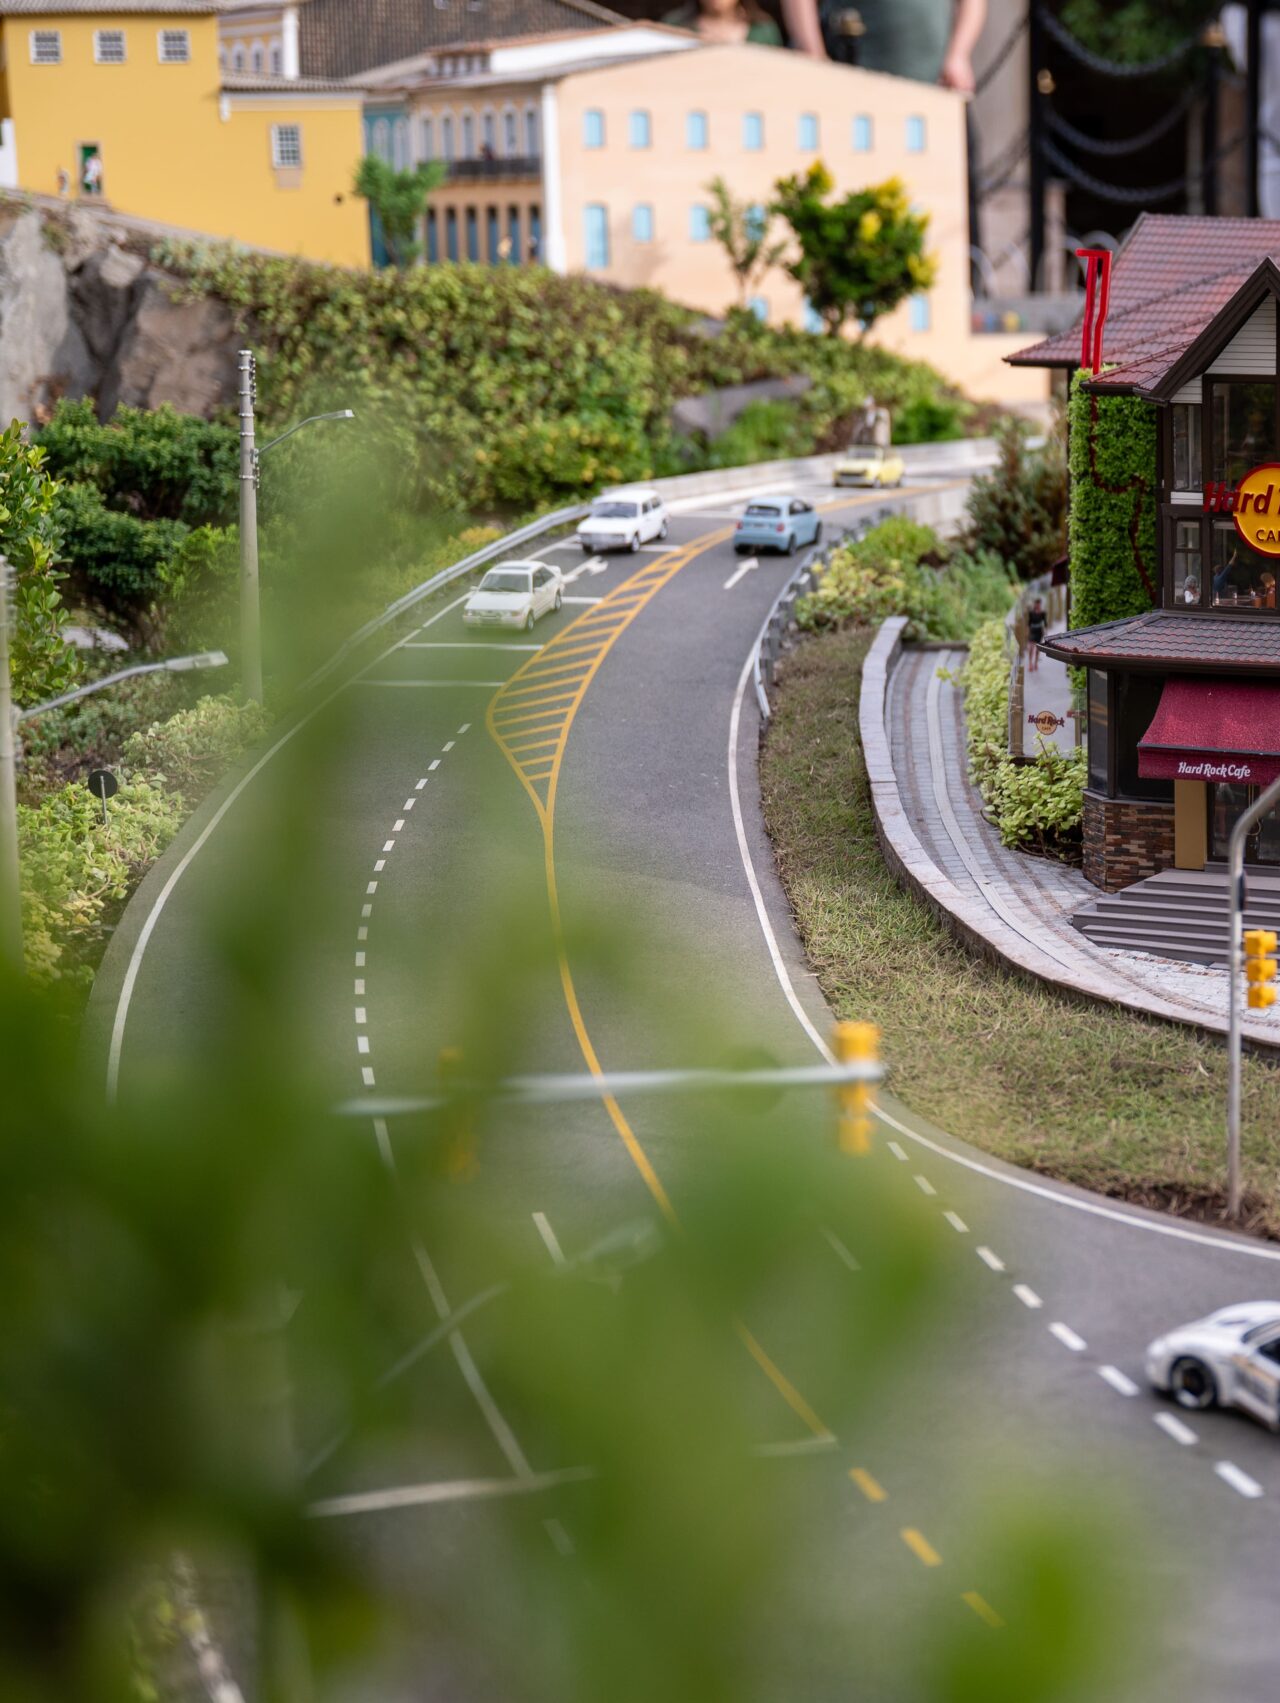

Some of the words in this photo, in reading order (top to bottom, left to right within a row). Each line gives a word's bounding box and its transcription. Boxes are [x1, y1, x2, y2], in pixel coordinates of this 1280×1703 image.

[1203, 481, 1274, 514] Hard
[1178, 762, 1203, 774] Hard
[1203, 763, 1227, 777] Rock
[1228, 764, 1250, 779] Cafe
